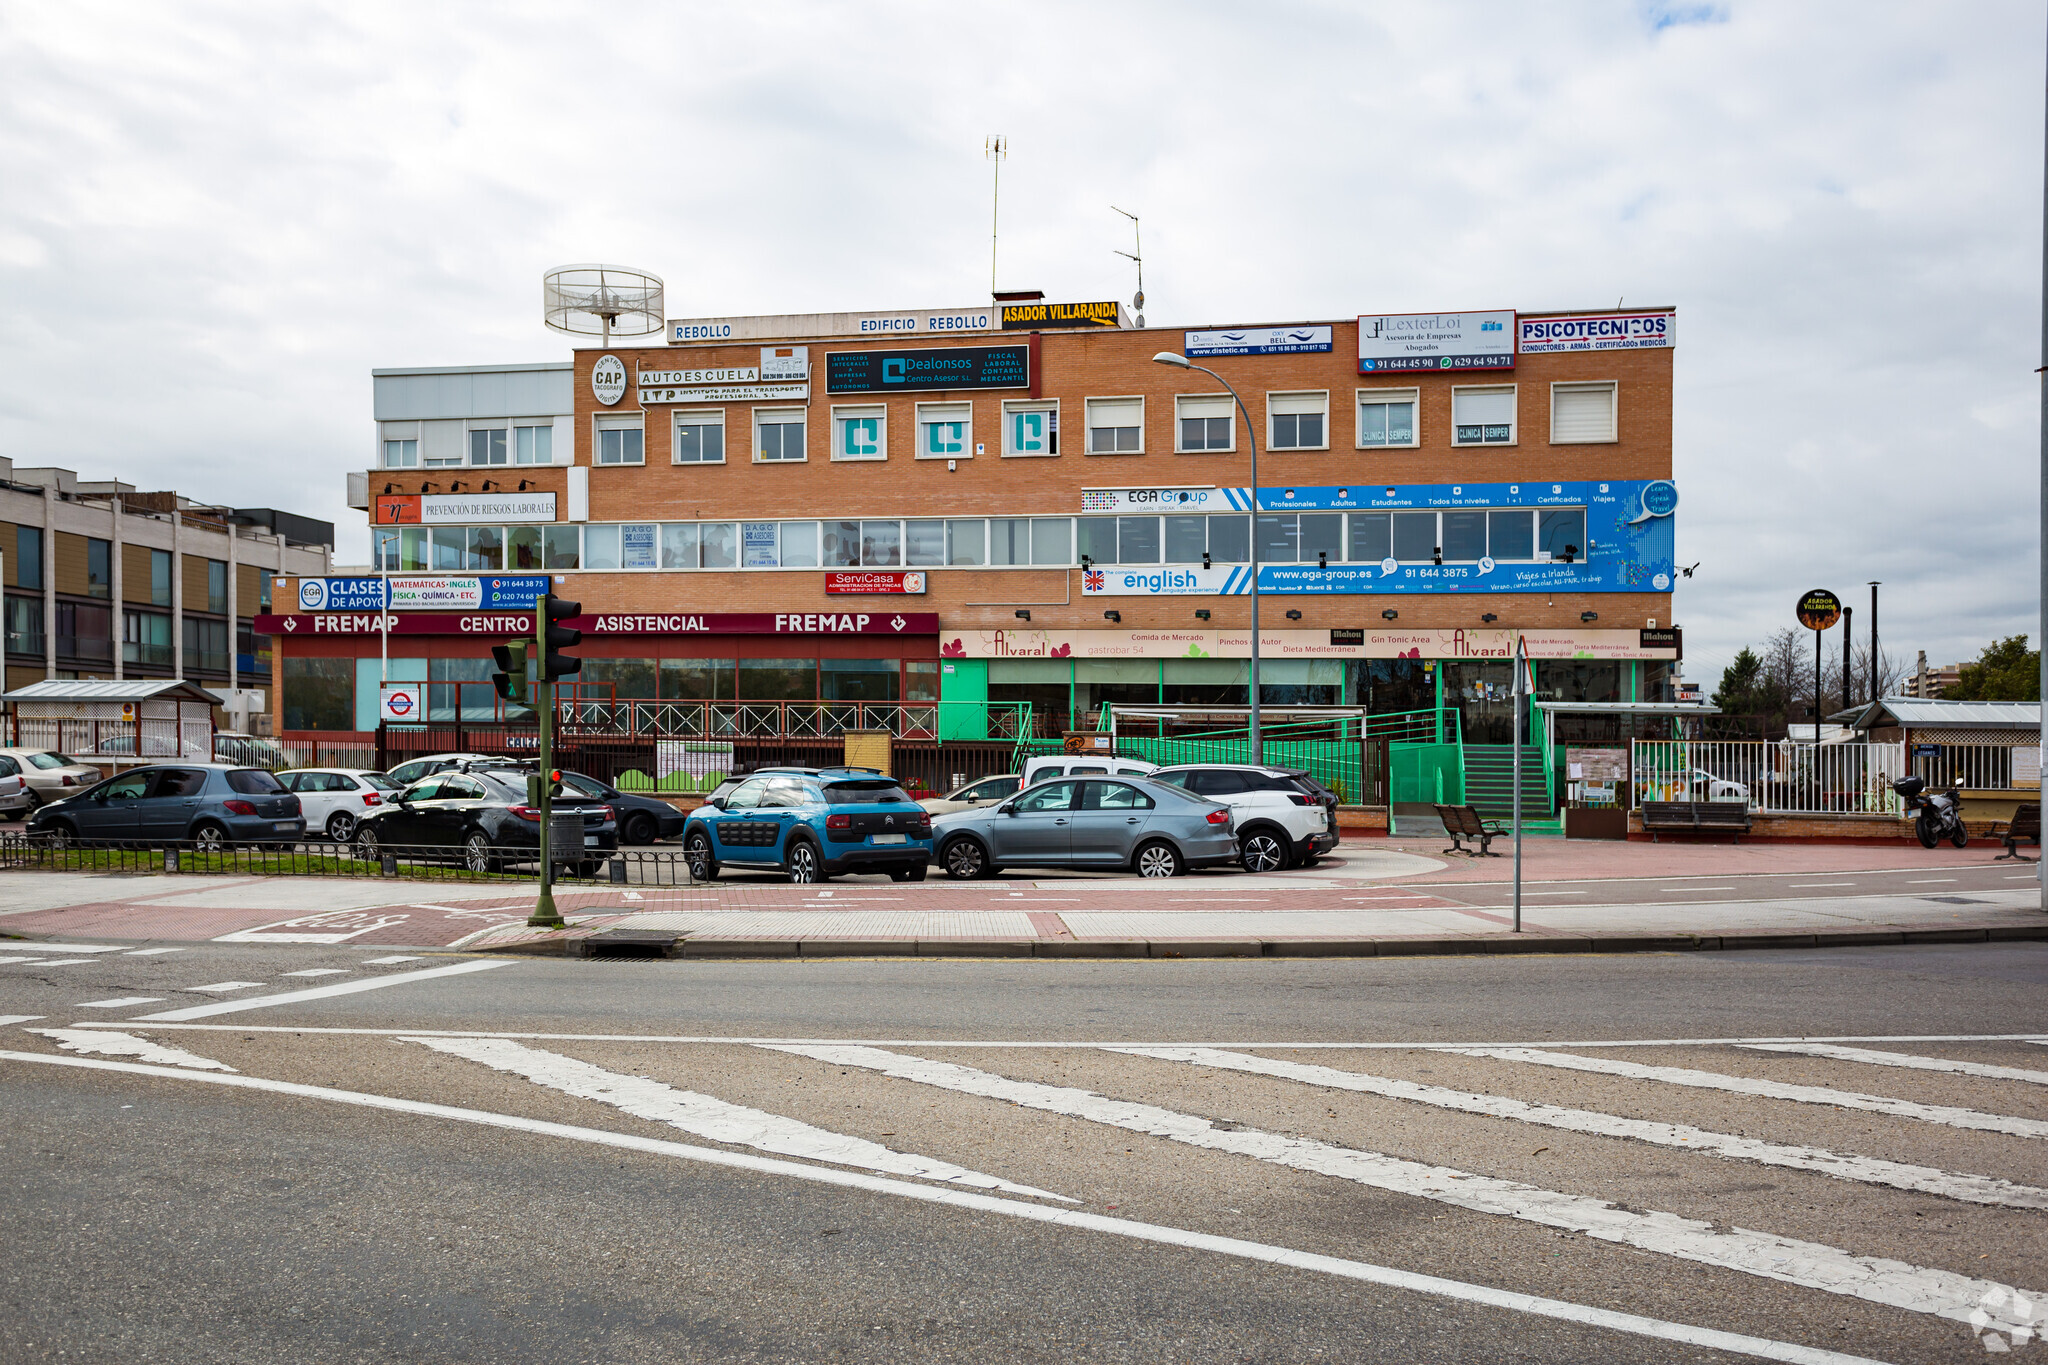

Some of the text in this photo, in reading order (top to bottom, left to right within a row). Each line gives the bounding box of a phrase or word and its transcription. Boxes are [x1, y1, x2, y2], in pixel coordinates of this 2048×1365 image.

[1003, 302, 1117, 322] ASADOR VILLARANDA
[862, 315, 987, 331] EDIFICIO REBOLLO
[1385, 315, 1461, 331] LexterLoi
[676, 324, 731, 339] REBOLLO
[1427, 332, 1462, 341] Empresas
[1270, 336, 1287, 344] BELL
[1191, 347, 1249, 355] www.distetic.es
[1404, 344, 1439, 352] Abogados
[1521, 344, 1566, 352] CONDUCTORES
[1570, 342, 1591, 350] ARMAS
[597, 357, 621, 370] CENTRO
[906, 357, 972, 370] Dealonsos
[1377, 358, 1434, 369] 91 644 45 90
[1455, 356, 1511, 366] 629 64 94 71
[596, 372, 622, 384] CAP
[642, 369, 755, 384] AUTOESCUELA
[906, 374, 959, 383] Centro Asesor
[598, 393, 619, 402] DIGITAL
[642, 390, 676, 402] ITP
[1363, 430, 1412, 441] CLINICA SEMPER
[1459, 427, 1509, 439] CLINICA SEMPER
[1128, 490, 1158, 503] EGA
[1270, 499, 1317, 507] Profesionales
[1330, 499, 1357, 507] Adultos
[1371, 498, 1413, 506] Estudiantes
[1537, 496, 1582, 504] Certificados
[1593, 495, 1616, 504] Viajes
[1650, 494, 1670, 504] Speak
[426, 502, 555, 516] PREVENCIÓN DE RIESGOS LABORALES
[1651, 504, 1670, 512] Travel
[633, 533, 653, 541] ASESORES
[753, 532, 774, 540] ASESORES
[836, 573, 894, 583] ServiCasa
[1273, 568, 1468, 582] www.ega-group.es 91 644 3875
[1516, 567, 1574, 583] Viajes Irlanda
[392, 579, 477, 588] MATEMÁTICAS INGLÉS
[1124, 570, 1197, 593] english
[1490, 582, 1512, 590] Verano,
[1513, 581, 1530, 589] curso
[1531, 579, 1552, 587] escolar,
[1581, 575, 1602, 583] trabajo
[304, 588, 321, 596] EGA
[330, 580, 383, 595] CLASES
[393, 591, 417, 600] FÍSICA
[421, 591, 455, 600] QUÍMICA
[331, 597, 346, 608] DE
[313, 614, 869, 632] FREMAP CENTRO ASISTENCIAL FREMAP
[1131, 633, 1204, 642] Comida de Mercado
[1333, 630, 1362, 638] Mahou
[1371, 635, 1385, 643] Gin
[1387, 635, 1409, 643] Tonic
[1643, 632, 1673, 640] Mahou
[994, 630, 1046, 657] Alvaral
[1219, 638, 1248, 646] Pinchos
[1261, 638, 1281, 646] Autor
[1454, 629, 1511, 657] Alvaral
[1088, 645, 1144, 655] gastrobar 54
[1283, 645, 1298, 653] Dieta
